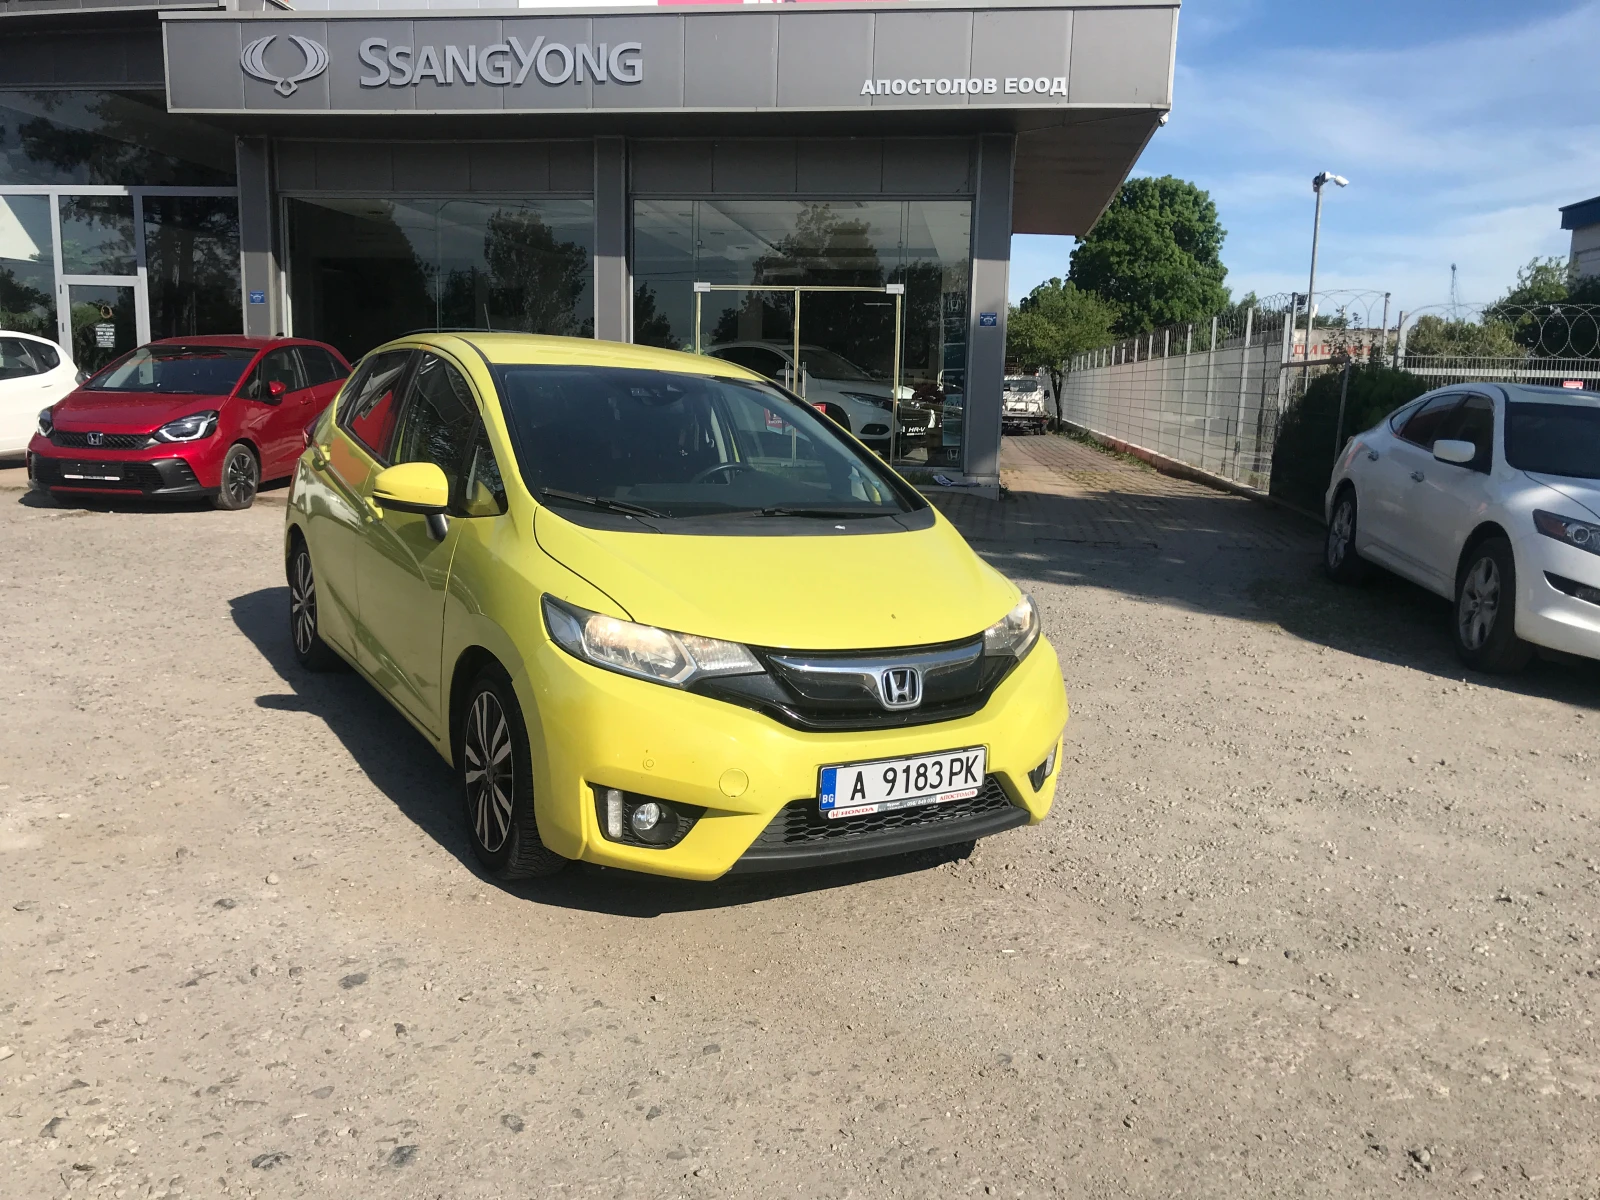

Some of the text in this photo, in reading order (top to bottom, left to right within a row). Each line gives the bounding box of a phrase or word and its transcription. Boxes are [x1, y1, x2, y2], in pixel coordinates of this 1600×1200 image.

[359, 35, 643, 87] SSANGYONG
[860, 77, 1067, 96] АПОСТОЛОВ ЕООД
[850, 754, 979, 801] A 9183 PK
[822, 793, 835, 804] BG
[841, 807, 875, 816] HONDA
